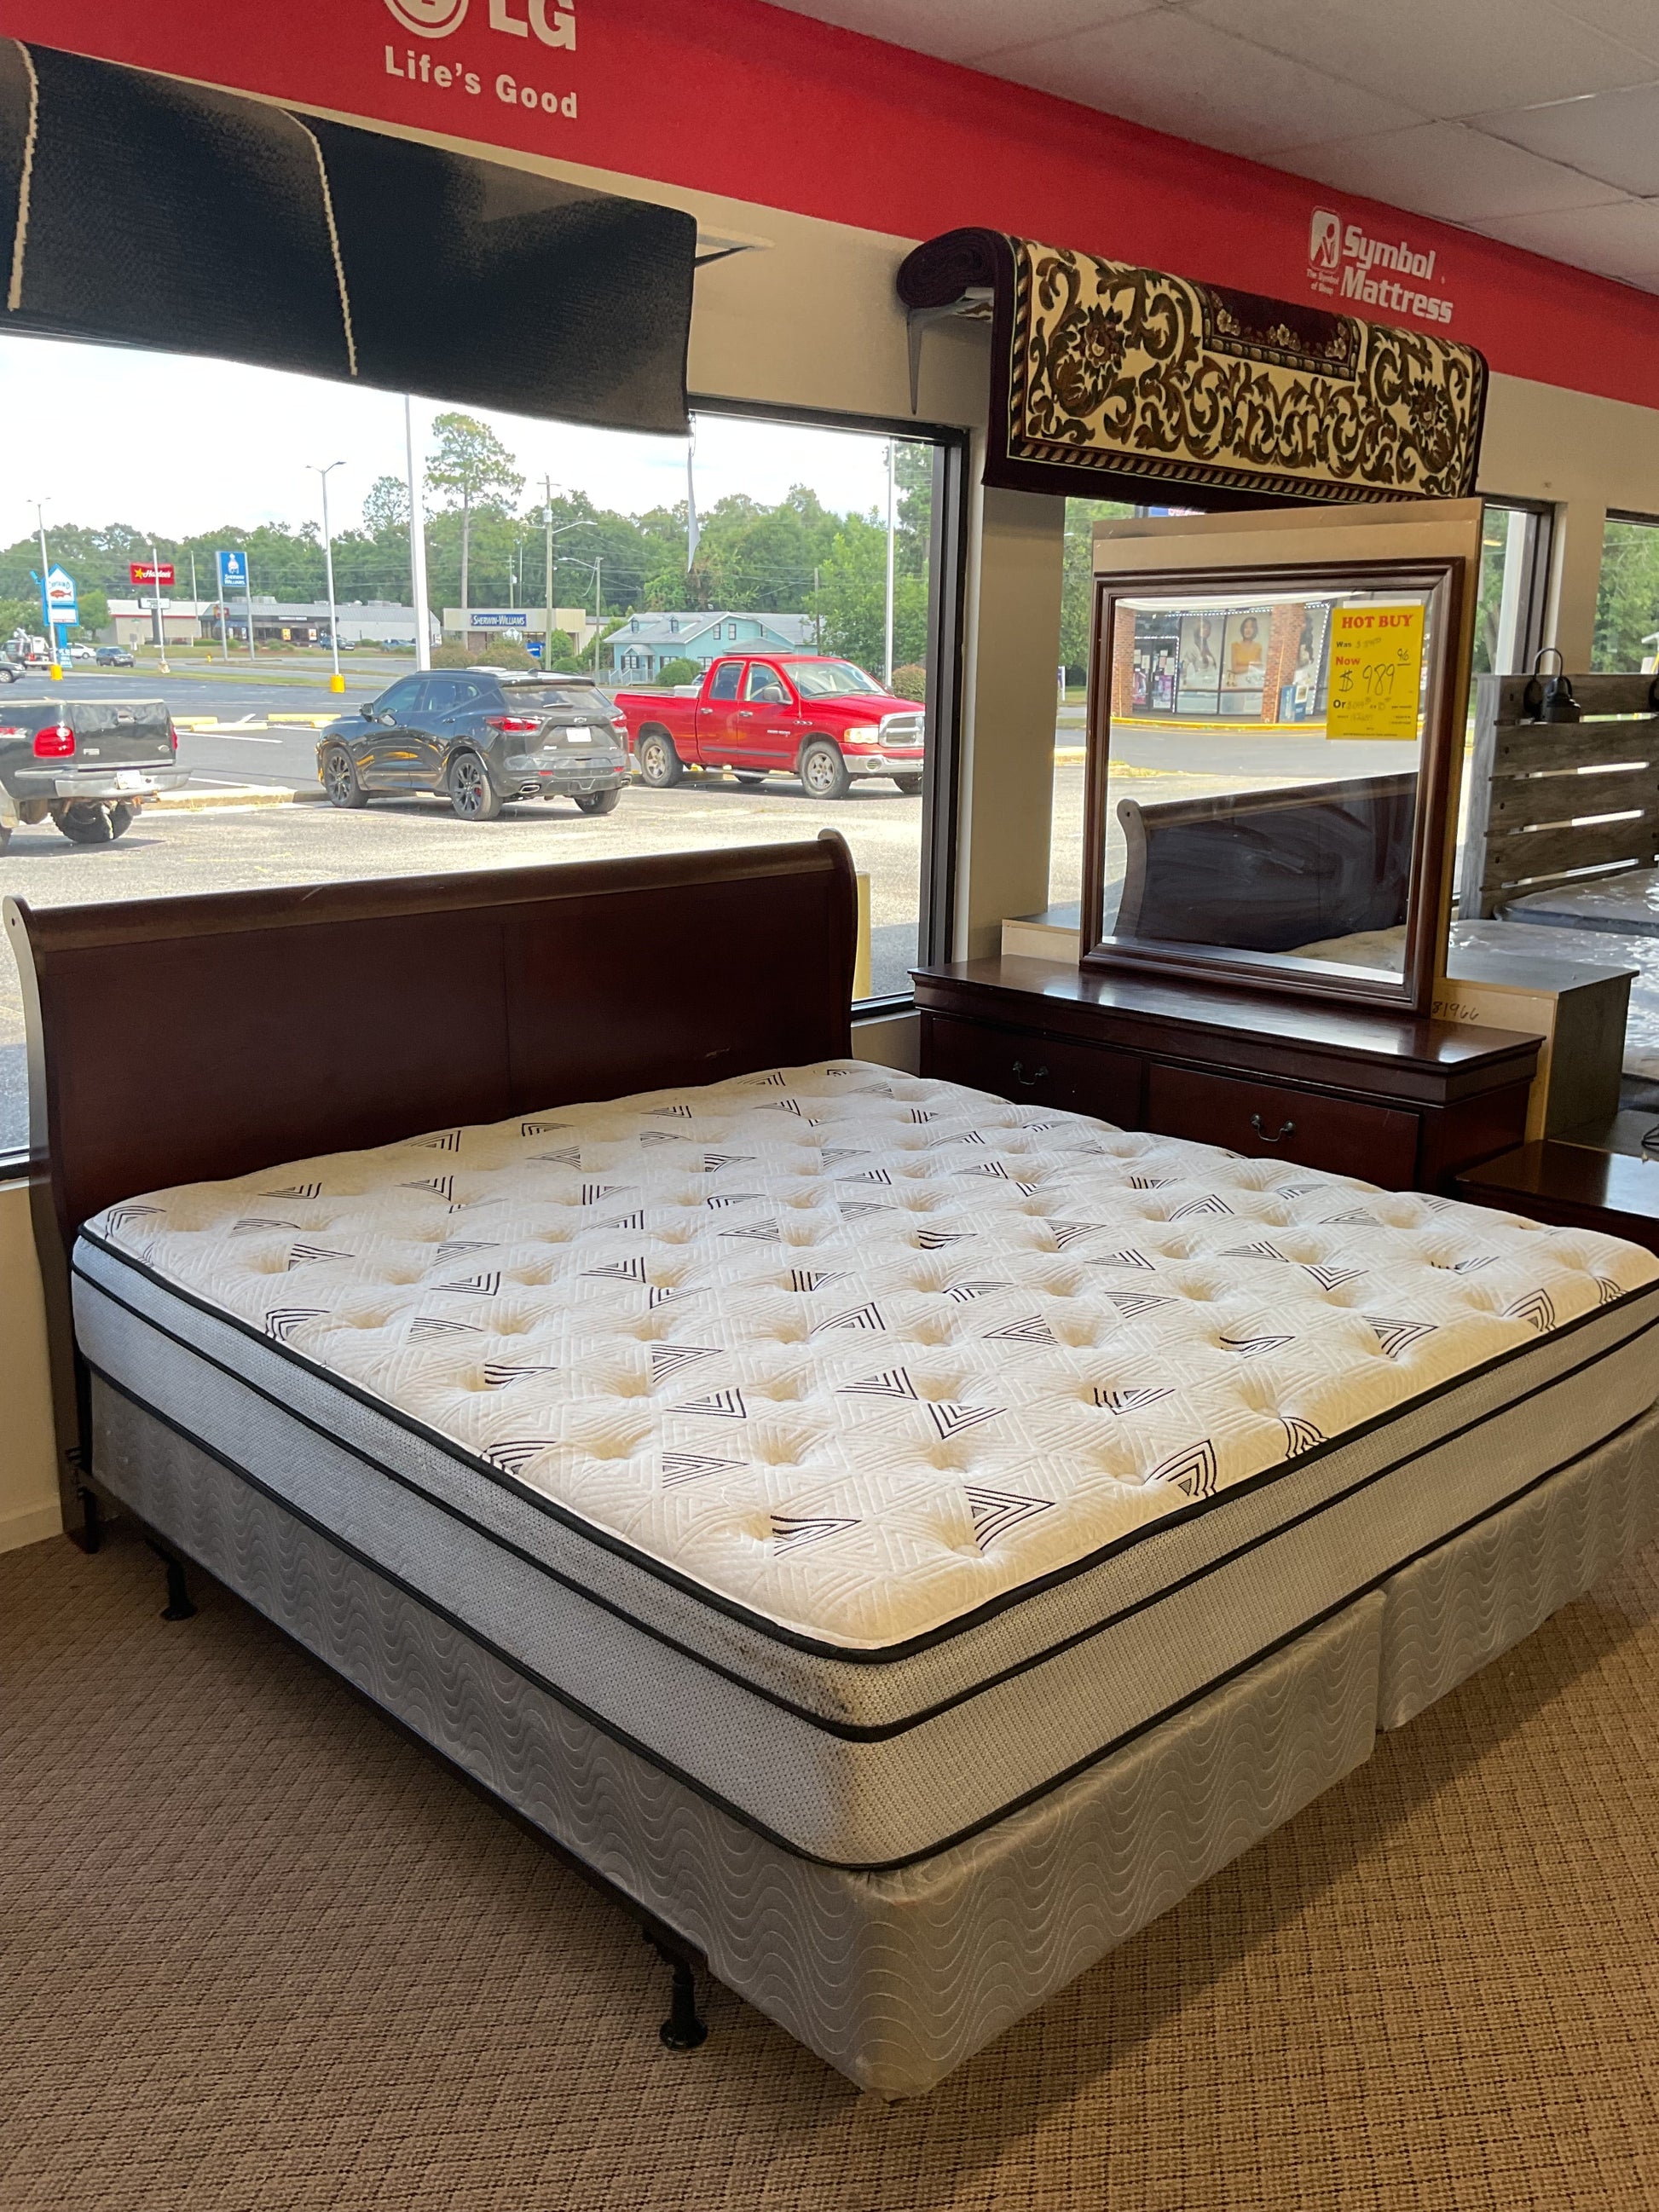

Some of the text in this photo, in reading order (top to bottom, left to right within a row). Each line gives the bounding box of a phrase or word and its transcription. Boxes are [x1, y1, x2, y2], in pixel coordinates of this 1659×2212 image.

[489, 0, 576, 51] LG
[385, 45, 577, 118] Life's Good
[1343, 225, 1436, 280] Symbol
[1340, 266, 1454, 324] Mattress
[1342, 615, 1414, 629] HOT BUY
[1336, 656, 1361, 666] Now
[1338, 663, 1396, 696] $ 989
[1332, 699, 1346, 709] Or
